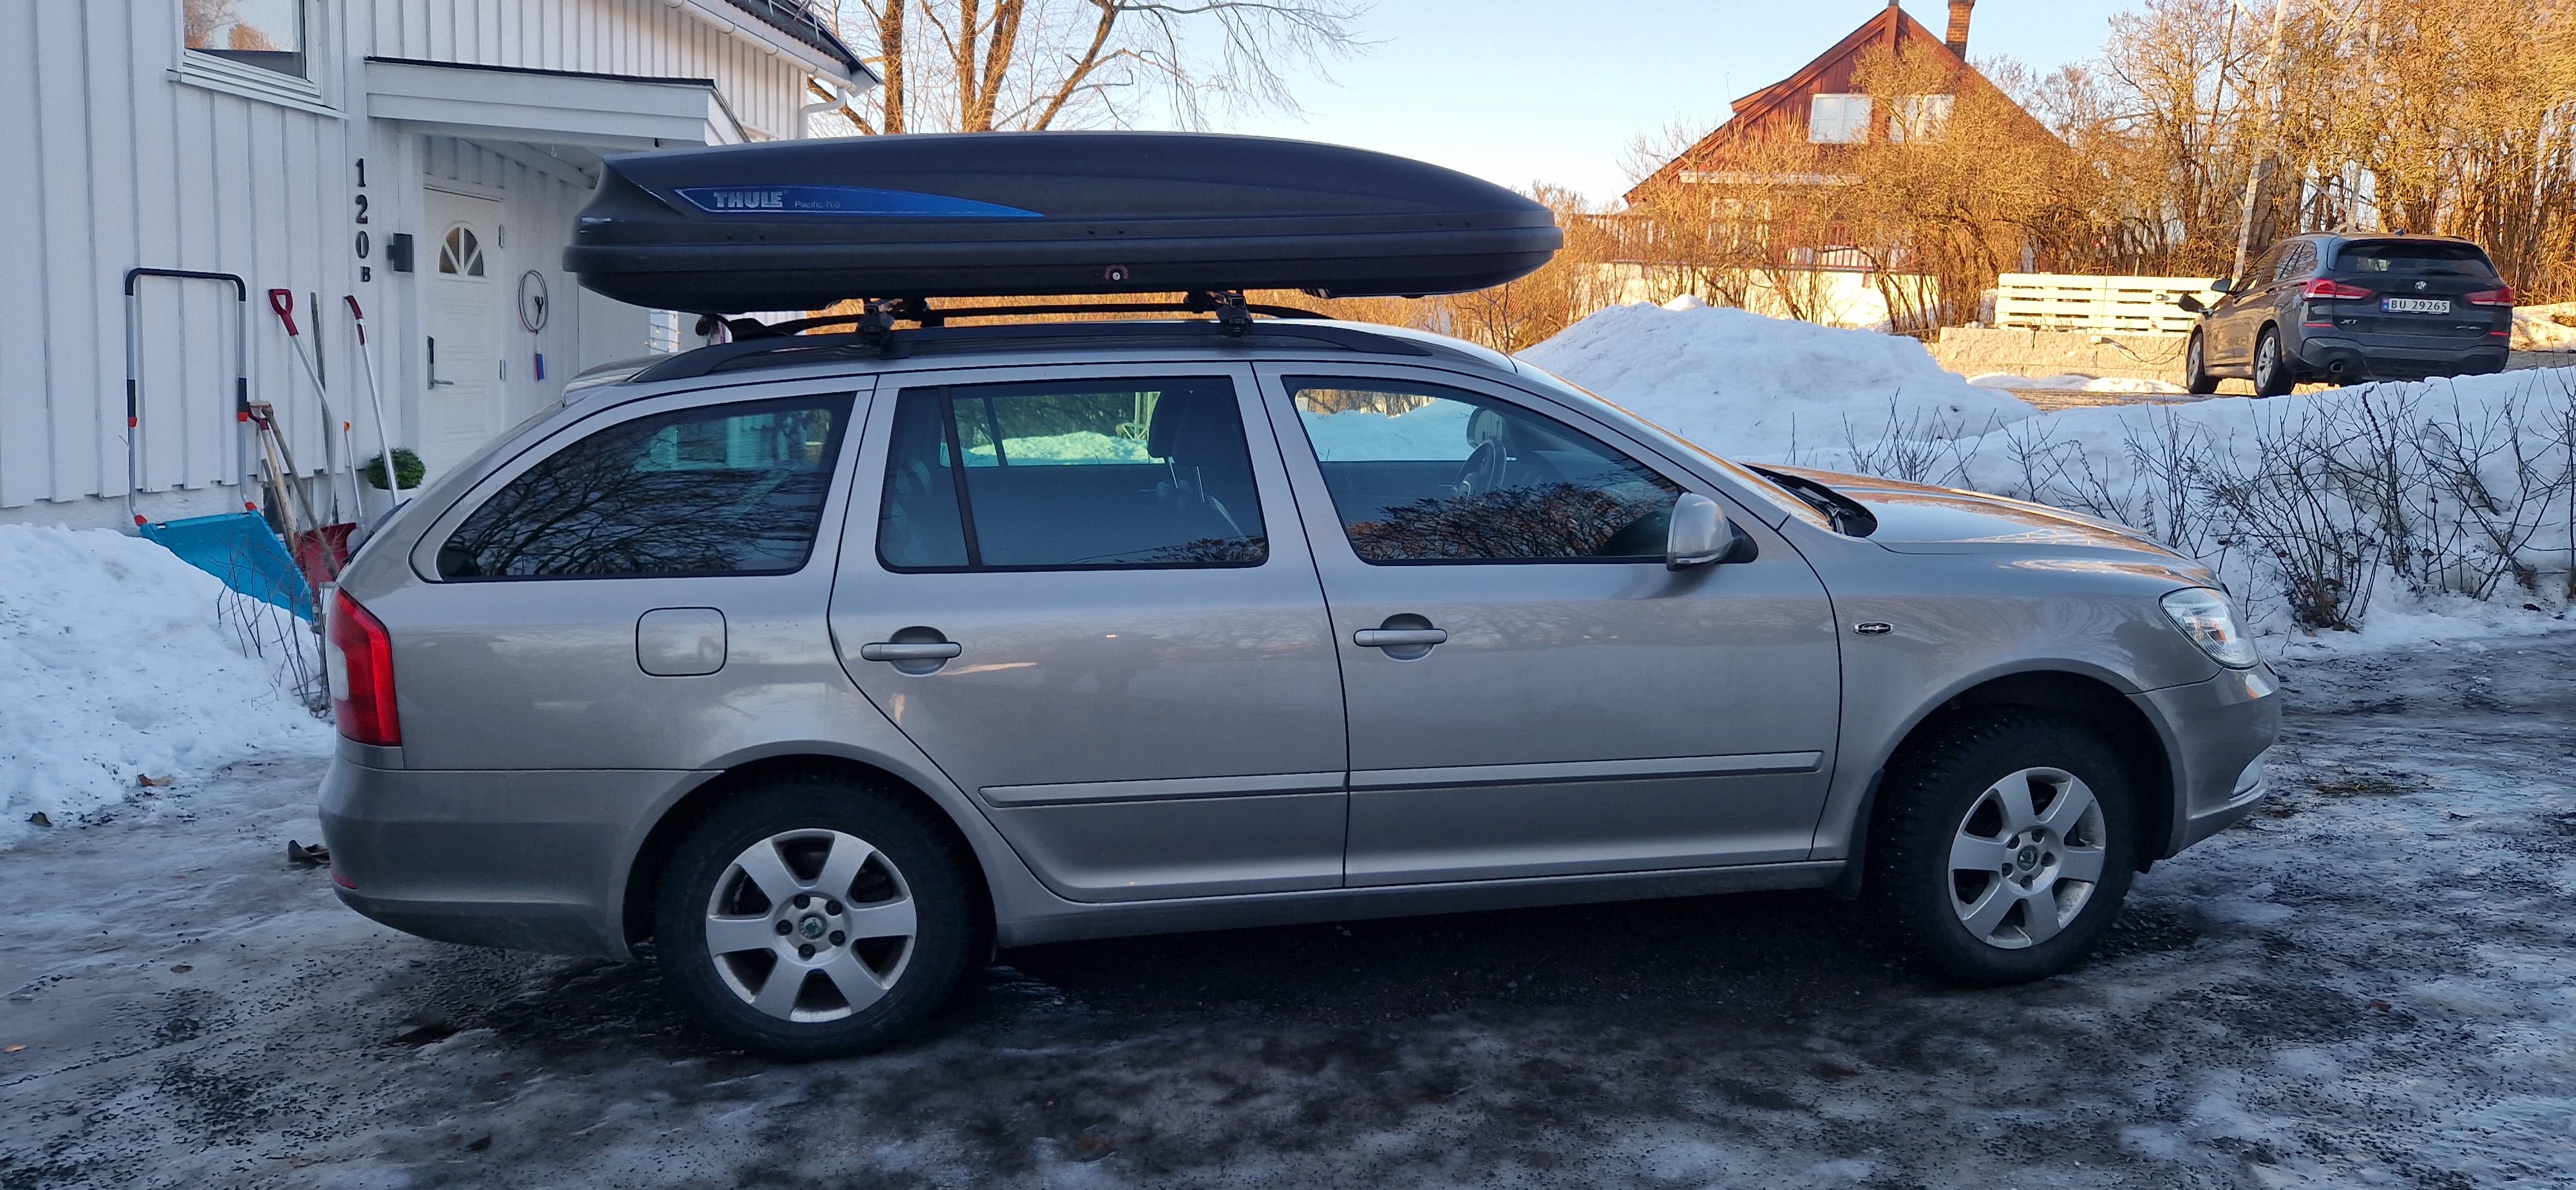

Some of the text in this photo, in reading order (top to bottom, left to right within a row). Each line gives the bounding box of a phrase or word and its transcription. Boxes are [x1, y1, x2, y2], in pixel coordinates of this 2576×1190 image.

[714, 191, 783, 208] THULE
[795, 200, 824, 209] Pacific
[2391, 300, 2447, 311] BU 29265
